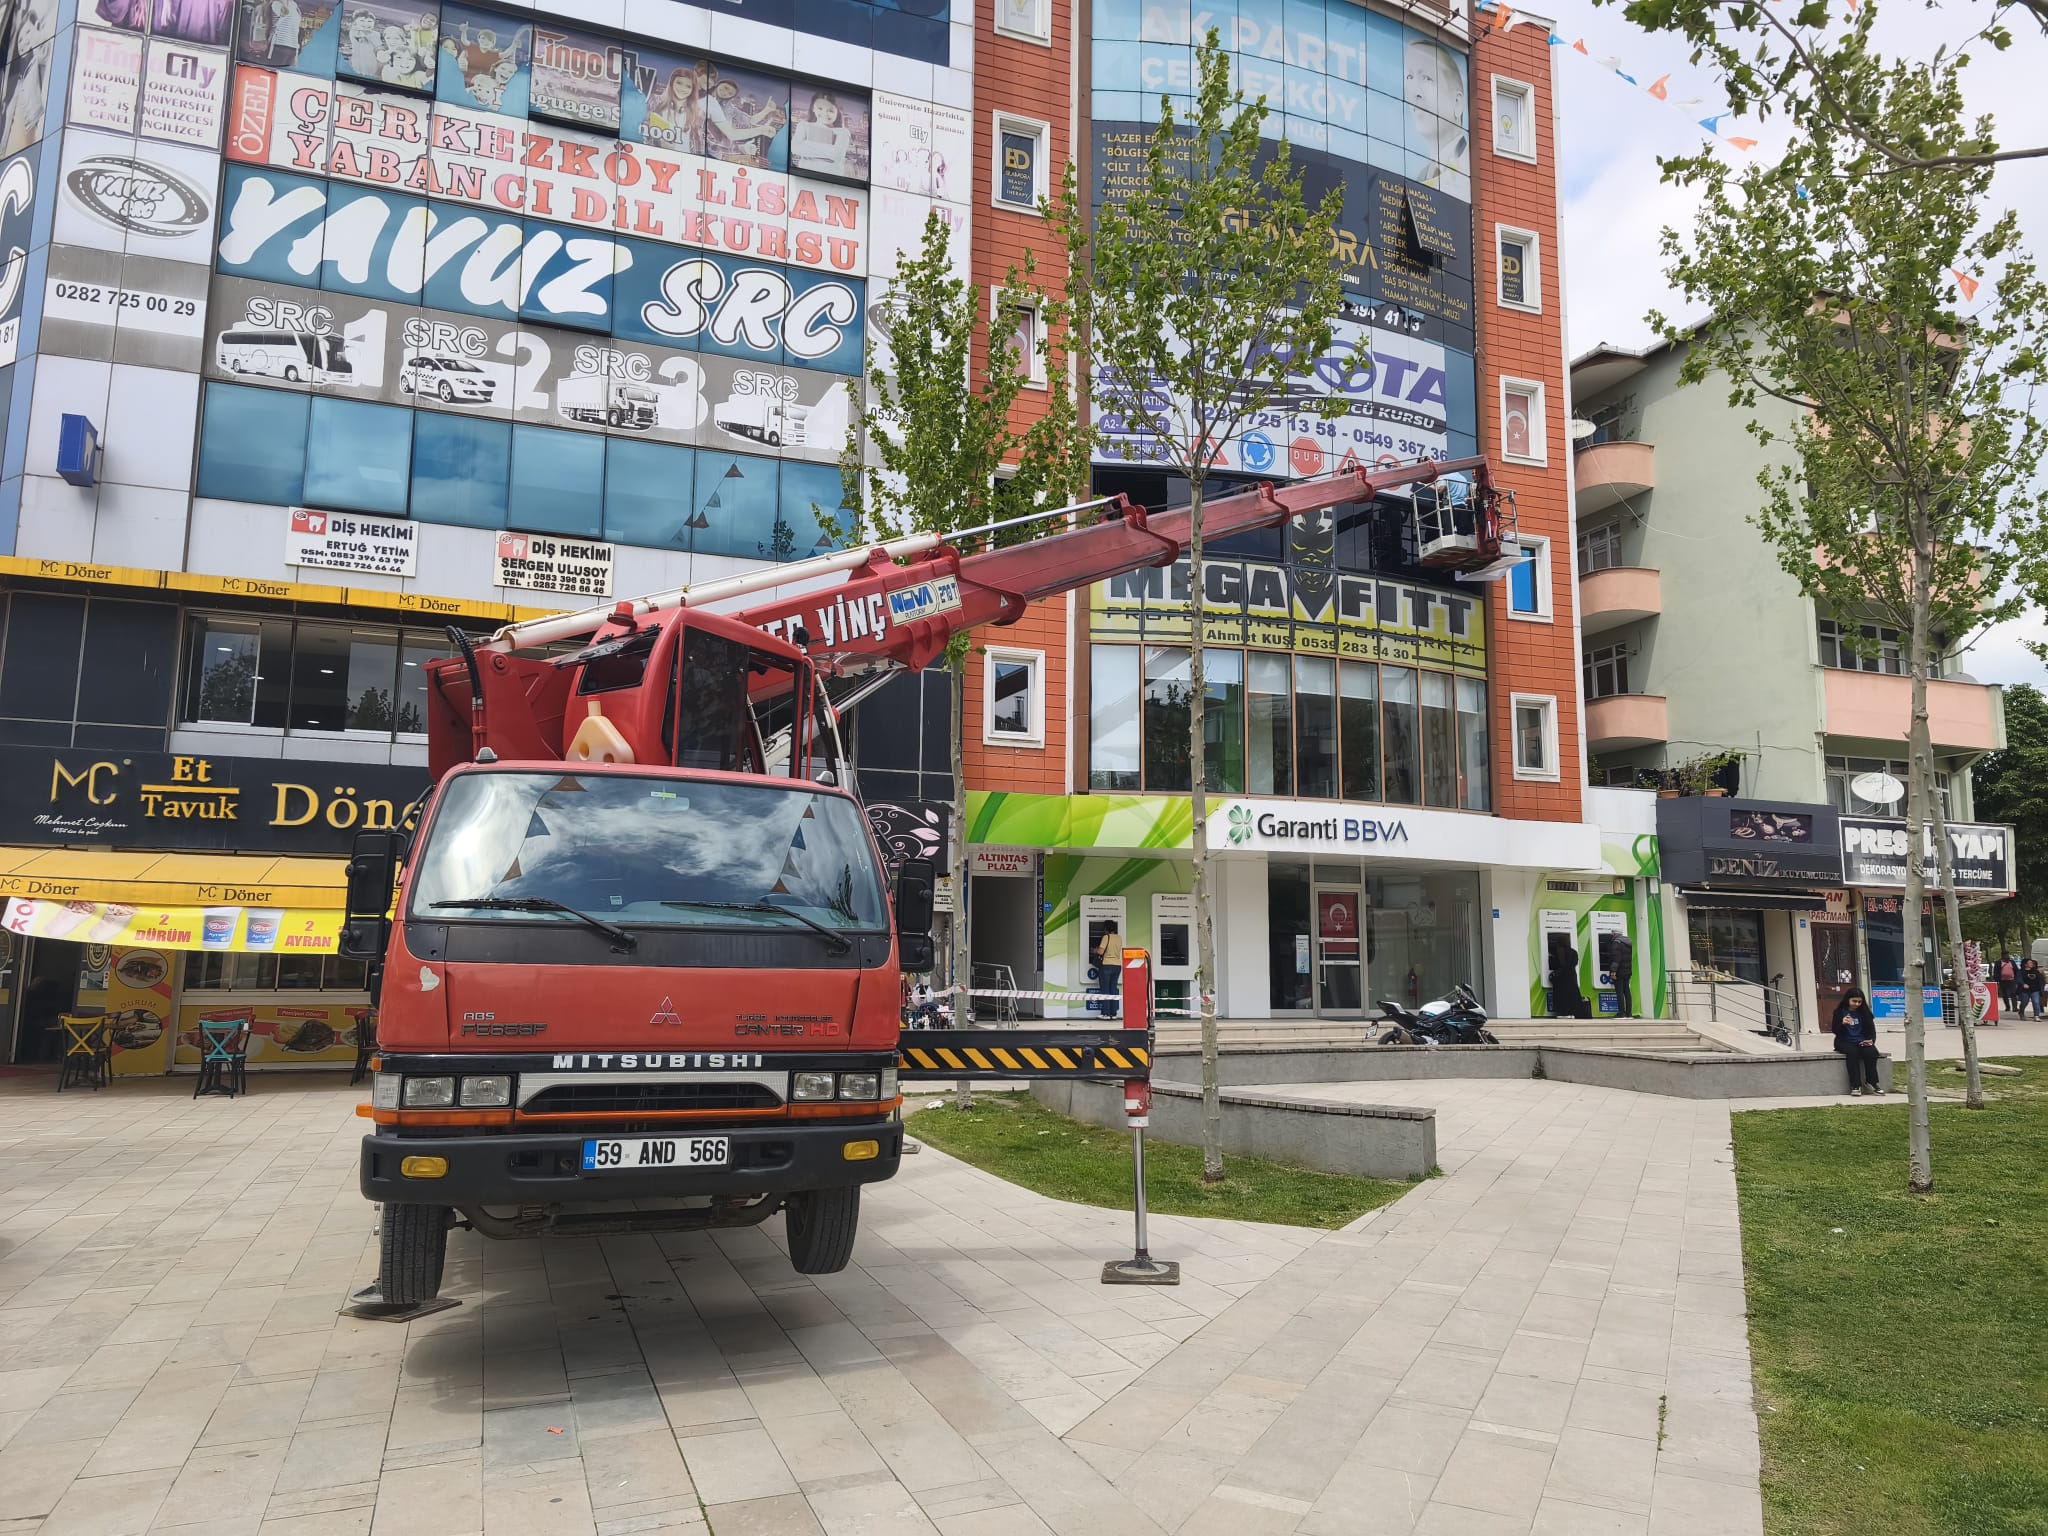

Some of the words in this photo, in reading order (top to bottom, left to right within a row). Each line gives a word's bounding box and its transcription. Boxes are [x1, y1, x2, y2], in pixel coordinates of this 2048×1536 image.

[1136, 8, 1213, 44] AK
[231, 75, 272, 155] ÖZEL
[290, 87, 681, 195] ÇERKEZKÖY
[696, 167, 859, 230] LİSAN
[94, 175, 167, 201] YAVUZ
[287, 131, 554, 215] YABANCI
[681, 209, 859, 271] KURSU
[219, 176, 633, 316] YAVUZ
[640, 257, 857, 359] SRC
[56, 283, 101, 302] 0282
[107, 290, 141, 308] 725
[146, 296, 168, 312] 00
[174, 301, 196, 316] 29
[245, 296, 334, 335] SRC
[403, 318, 488, 357] SRC
[495, 331, 551, 411] 2
[574, 345, 651, 382] SRC
[658, 356, 709, 430] 3
[733, 370, 799, 402] SRC
[1378, 408, 1435, 429] KURSU
[1248, 412, 1281, 428] 725
[1288, 419, 1310, 433] 13
[1316, 422, 1336, 437] 58
[1353, 429, 1393, 449] 0549
[1399, 439, 1426, 457] 367
[1294, 452, 1320, 463] DUR
[332, 518, 356, 536] DİŞ
[360, 523, 413, 540] HEKİMİ
[326, 540, 367, 553] ERTUĞ
[373, 545, 409, 557] YETİM
[532, 539, 556, 558] DİŞ
[561, 544, 611, 562] HEKİMİ
[64, 563, 113, 580] Döner
[354, 562, 372, 570] 726
[501, 558, 554, 573] SERGEN
[558, 563, 608, 578] ULUSOY
[245, 581, 291, 596] Döner
[890, 586, 933, 614] NOVA
[420, 598, 460, 612] Döner
[1337, 575, 1476, 639] FITT
[816, 593, 886, 648] VİNÇ
[1206, 629, 1257, 643] Ahmet
[1302, 637, 1337, 649] 0539
[1342, 641, 1368, 654] 283
[1393, 648, 1409, 660] 30
[50, 759, 119, 805] MC
[171, 756, 212, 783] Et
[33, 814, 85, 826] Mehmet
[140, 794, 239, 821] Tavuk
[1257, 813, 1338, 840] Garanti
[1343, 819, 1409, 842] BBVA
[977, 853, 1029, 865] ALTINTAŞ
[1951, 833, 2004, 861] YAPI
[987, 863, 1018, 871] PLAZA
[1710, 853, 1780, 878] DENİZ
[1860, 864, 1907, 877] DEKORASYO
[1959, 868, 1993, 880] TERCÜME
[27, 883, 80, 897] Döner
[223, 888, 272, 903] Döner
[159, 914, 169, 926] 2
[304, 920, 314, 932] 2
[135, 928, 191, 943] DÜRÜM
[285, 935, 332, 948] AYRAN
[463, 1012, 495, 1021] ABS
[735, 1024, 804, 1036] CANTER
[810, 1023, 840, 1036] HD
[552, 1054, 763, 1070] MITSUBISHI
[584, 1157, 595, 1165] TR
[596, 1142, 622, 1166] 59
[638, 1140, 676, 1165] AND
[689, 1137, 726, 1163] 566
